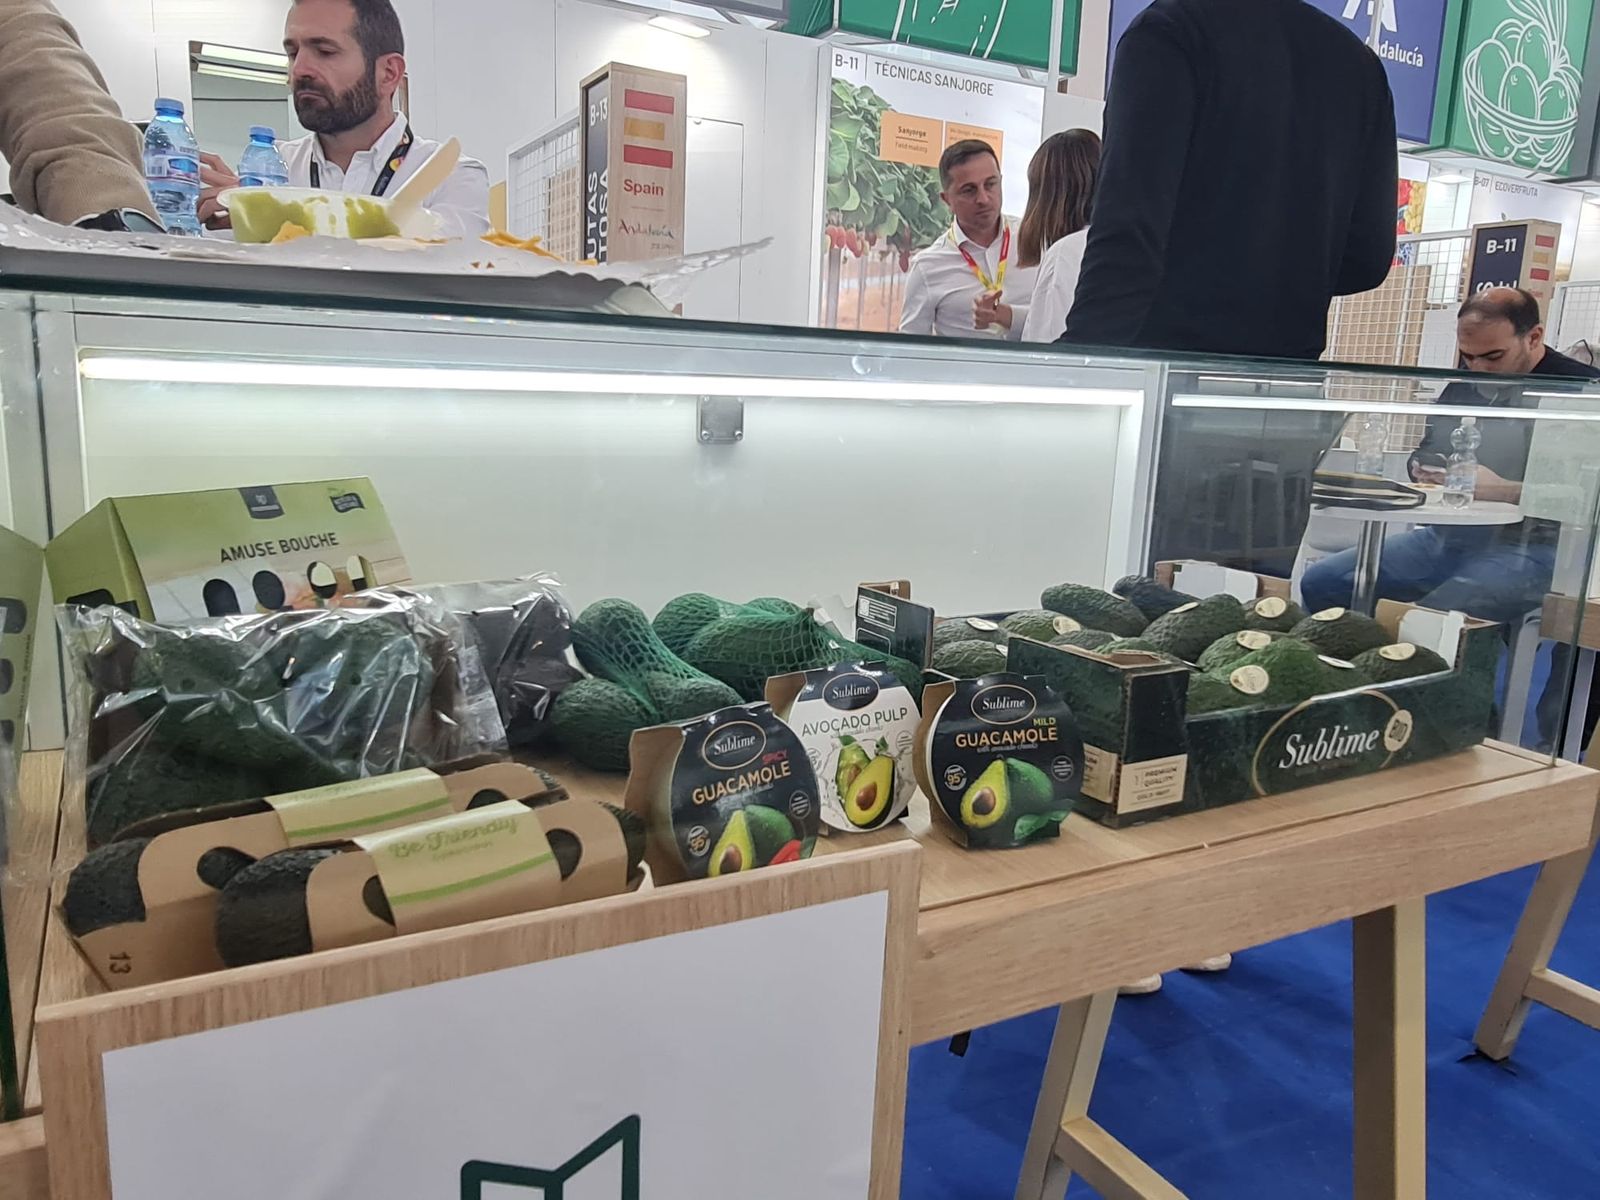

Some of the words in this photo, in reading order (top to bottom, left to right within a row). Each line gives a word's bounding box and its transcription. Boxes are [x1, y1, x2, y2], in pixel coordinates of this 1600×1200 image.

[835, 53, 859, 70] B-11
[875, 60, 932, 84] TÉCNICAS
[935, 73, 994, 96] SANJORGE
[590, 97, 608, 127] B-13
[624, 178, 664, 197] Spain
[1495, 181, 1538, 197] ECOVERFRUTA
[1486, 238, 1517, 254] B-11
[220, 541, 277, 563] AMUSE
[279, 532, 339, 553] BOUCHE
[832, 683, 871, 700] Sublime
[982, 696, 1026, 710] Sublime
[802, 713, 871, 737] AVOCADO
[874, 707, 908, 724] PULP
[1033, 717, 1056, 726] MILD
[714, 734, 756, 755] Sublime
[955, 727, 1058, 748] GUACAMOLE
[1278, 725, 1380, 769] Sublime
[692, 760, 792, 805] GUACAMOLE
[109, 952, 132, 974] 13
